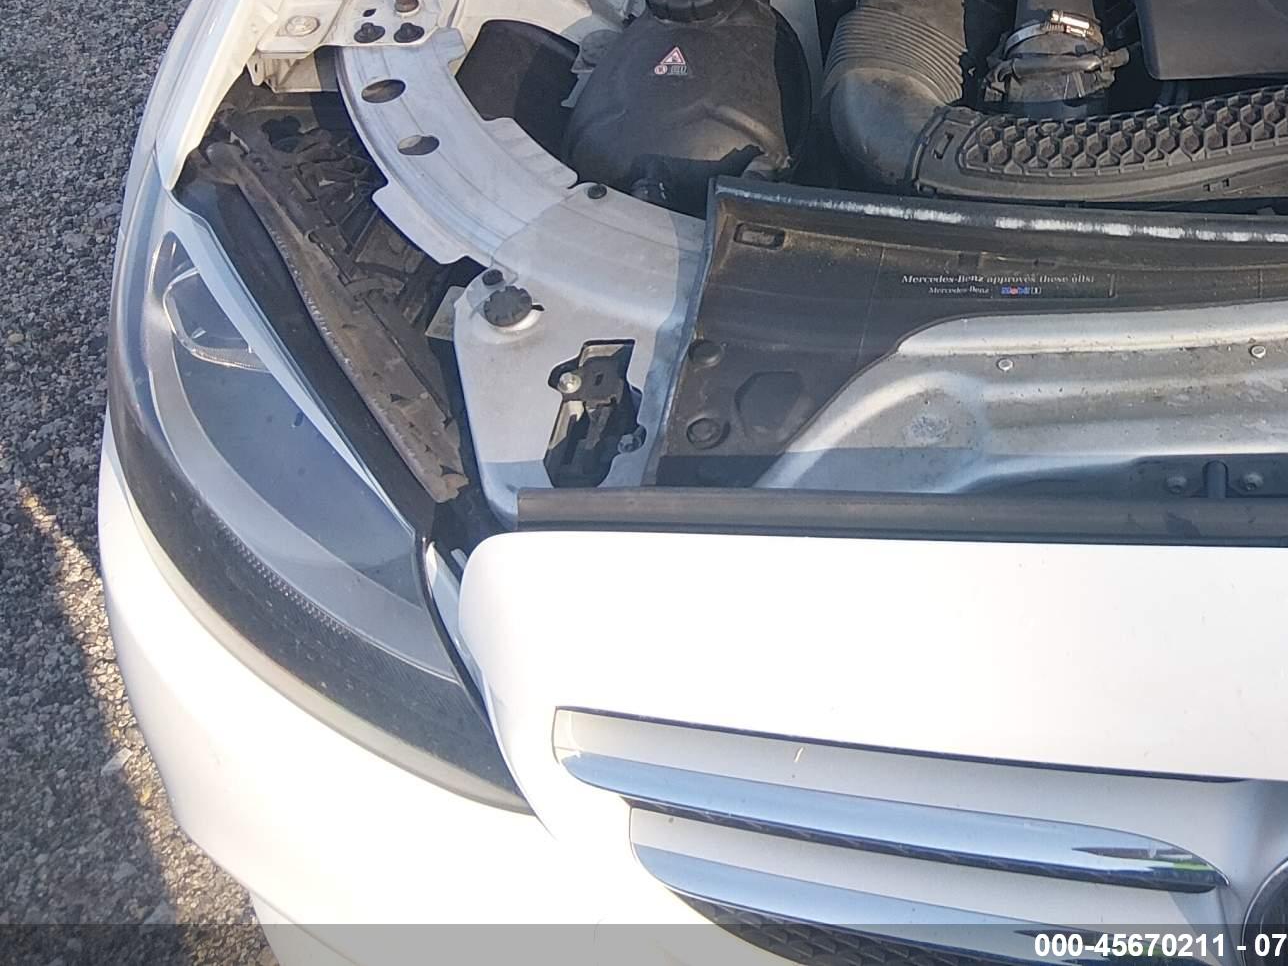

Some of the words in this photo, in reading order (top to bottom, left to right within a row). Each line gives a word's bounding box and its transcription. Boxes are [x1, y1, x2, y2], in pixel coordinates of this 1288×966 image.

[901, 275, 984, 284] Mercedes-Benz
[987, 274, 1036, 285] approves
[1039, 274, 1069, 283] these
